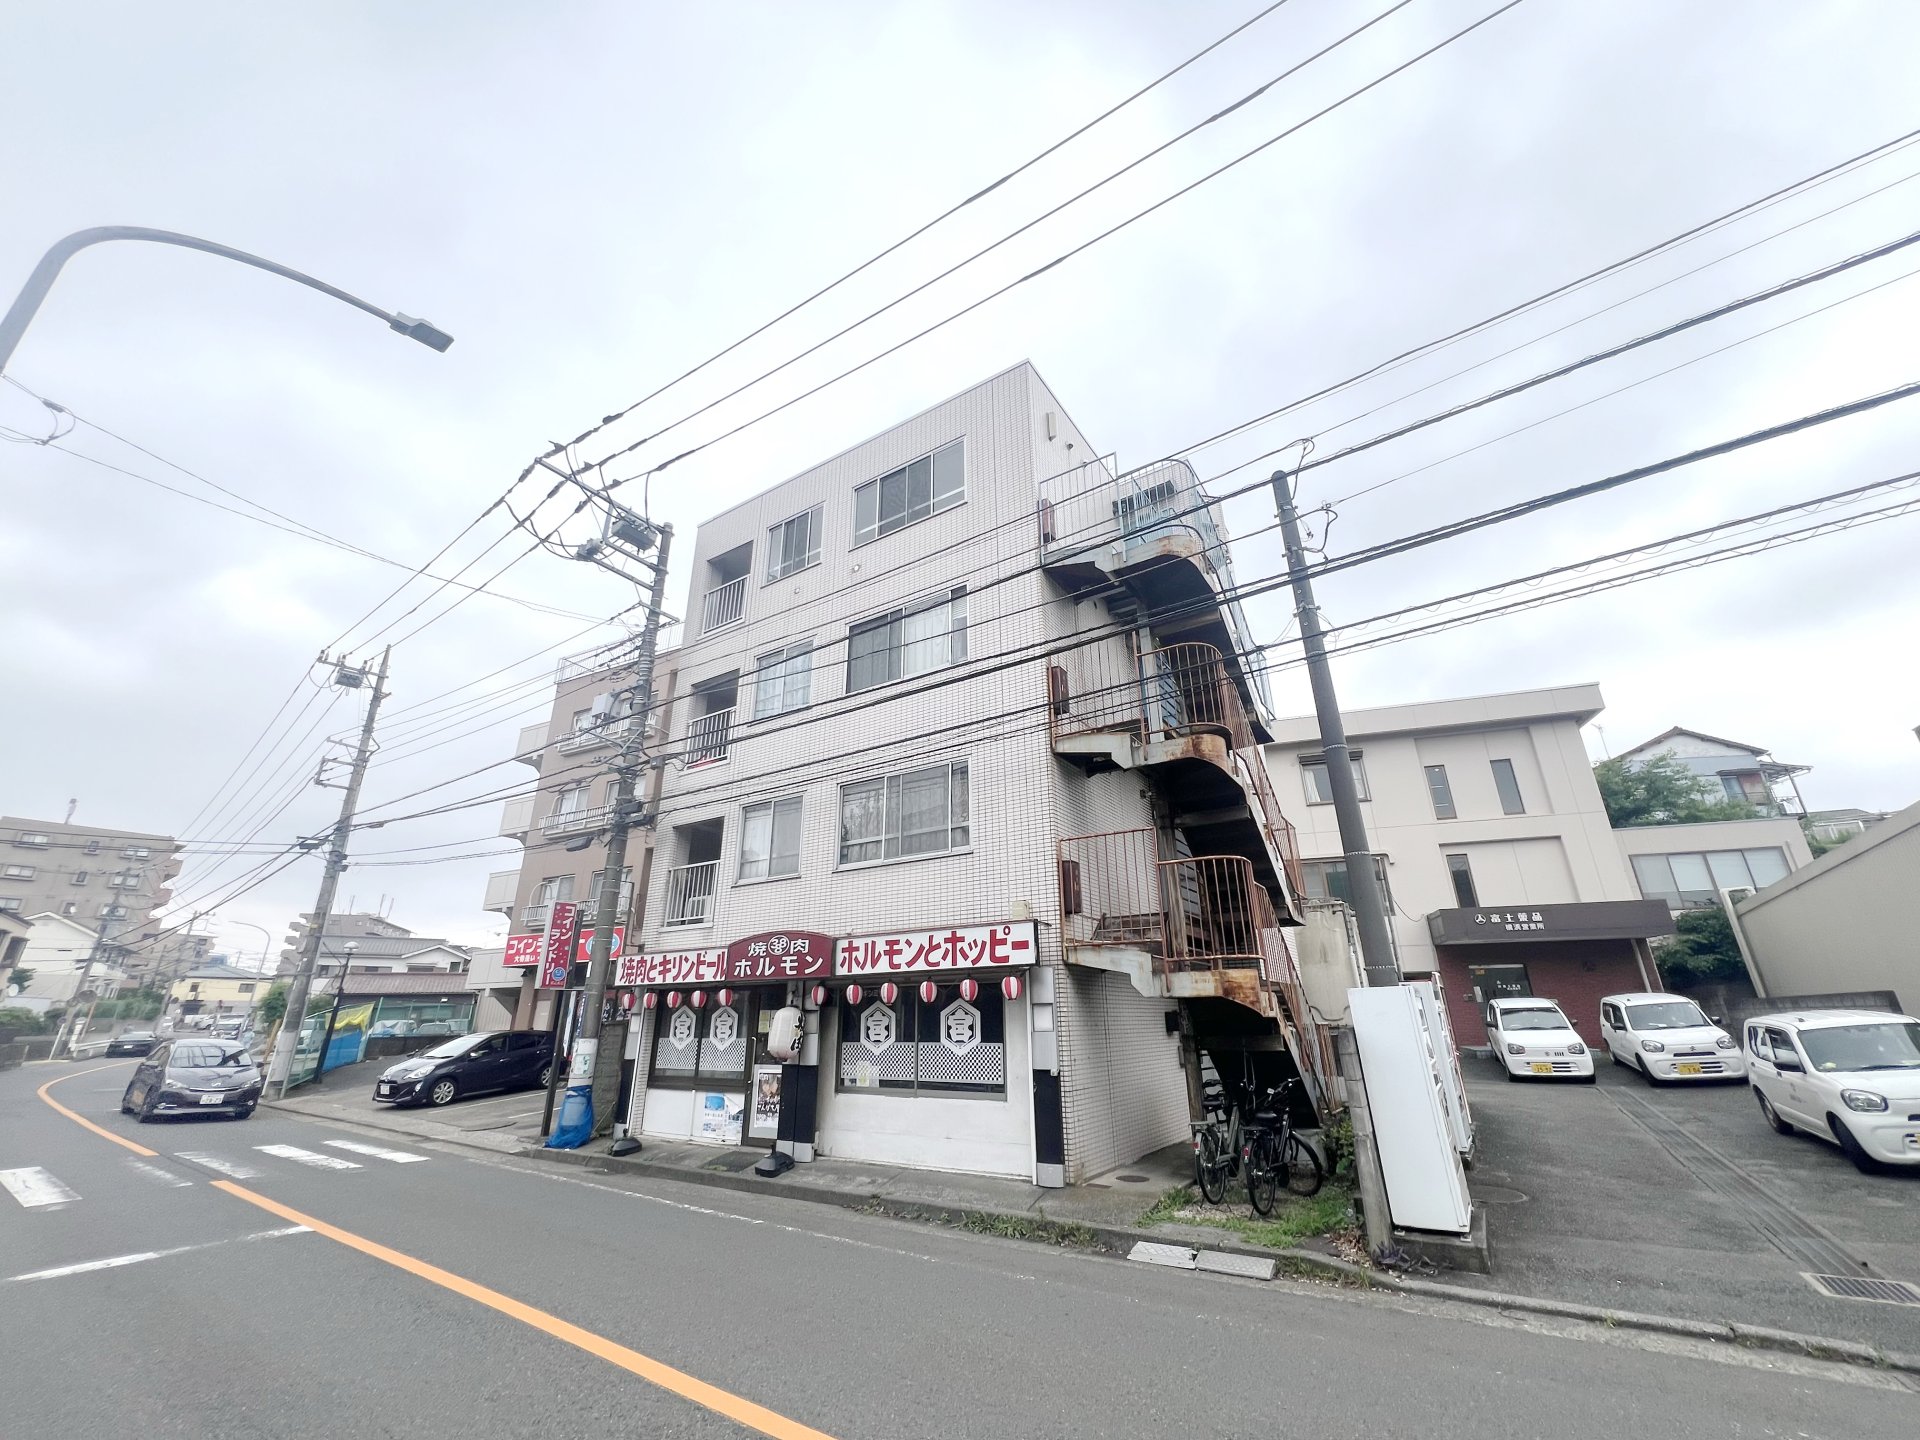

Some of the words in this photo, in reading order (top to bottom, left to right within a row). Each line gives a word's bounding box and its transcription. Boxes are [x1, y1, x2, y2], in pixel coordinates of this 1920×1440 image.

[560, 905, 577, 940] コイン
[545, 929, 562, 985] ランドリー
[733, 954, 824, 978] ホルモン
[839, 925, 1030, 973] ホルモンとホッピー
[619, 950, 727, 985] 焼肉とキリンビール
